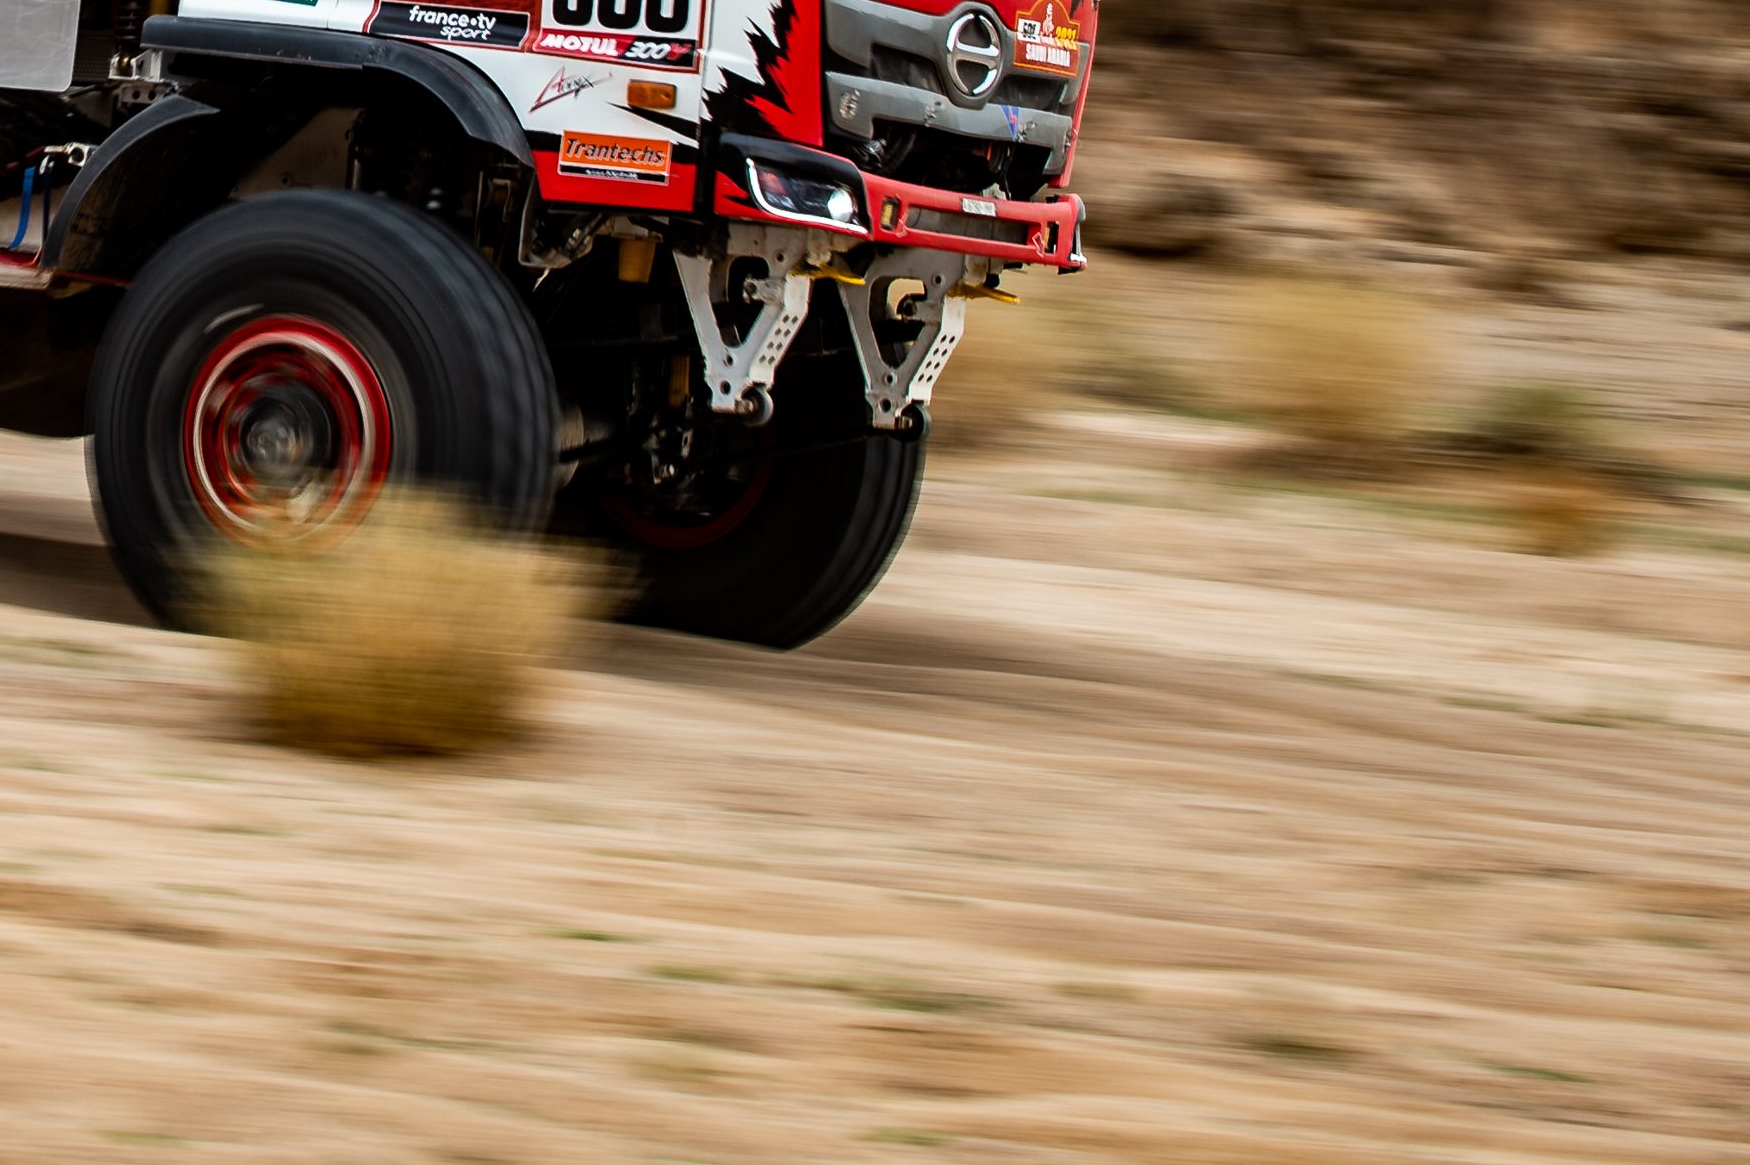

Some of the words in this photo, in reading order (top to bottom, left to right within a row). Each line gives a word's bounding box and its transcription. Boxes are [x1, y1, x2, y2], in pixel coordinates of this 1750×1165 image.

[439, 25, 492, 41] sport
[540, 33, 620, 57] MOTUL
[565, 137, 667, 167] Trantechs
